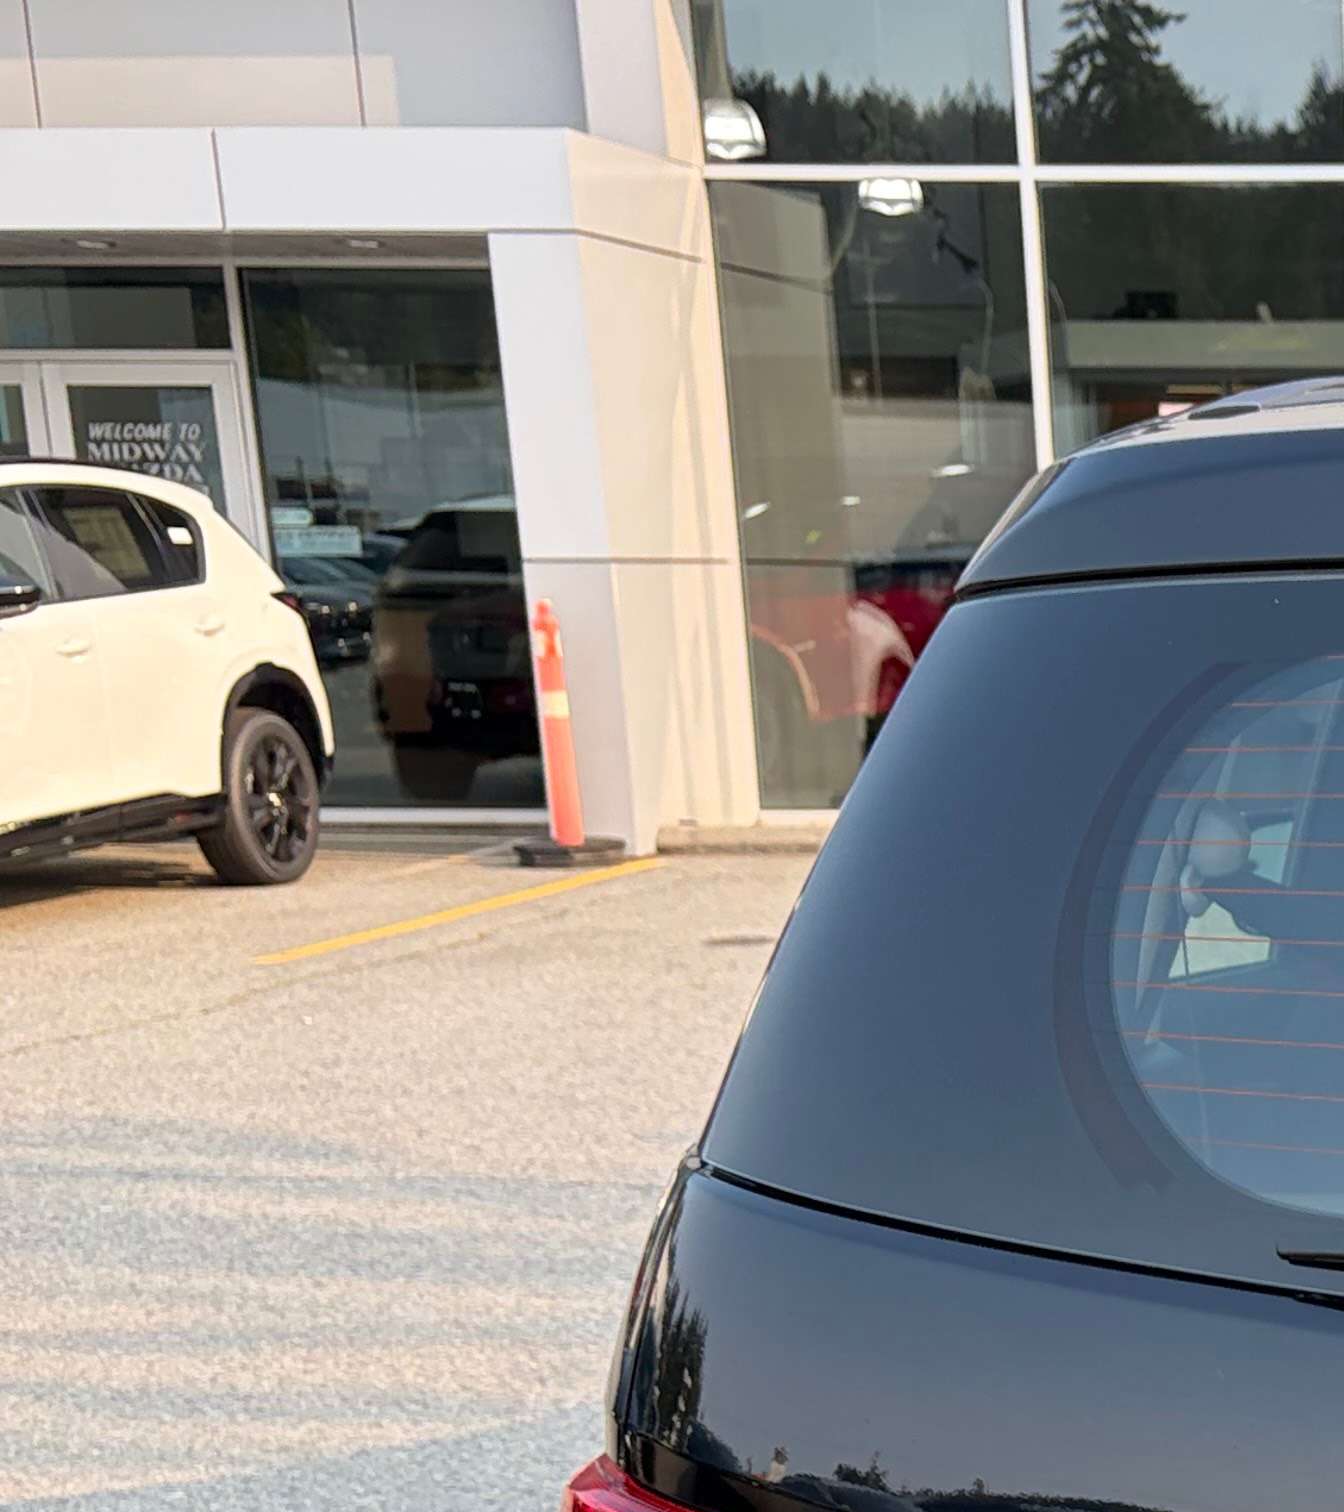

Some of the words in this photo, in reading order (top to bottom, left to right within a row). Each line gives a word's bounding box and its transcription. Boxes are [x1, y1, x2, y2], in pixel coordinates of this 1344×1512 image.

[88, 422, 172, 441] WELCOME
[178, 422, 200, 441] TO
[87, 441, 207, 463] MIDWAY
